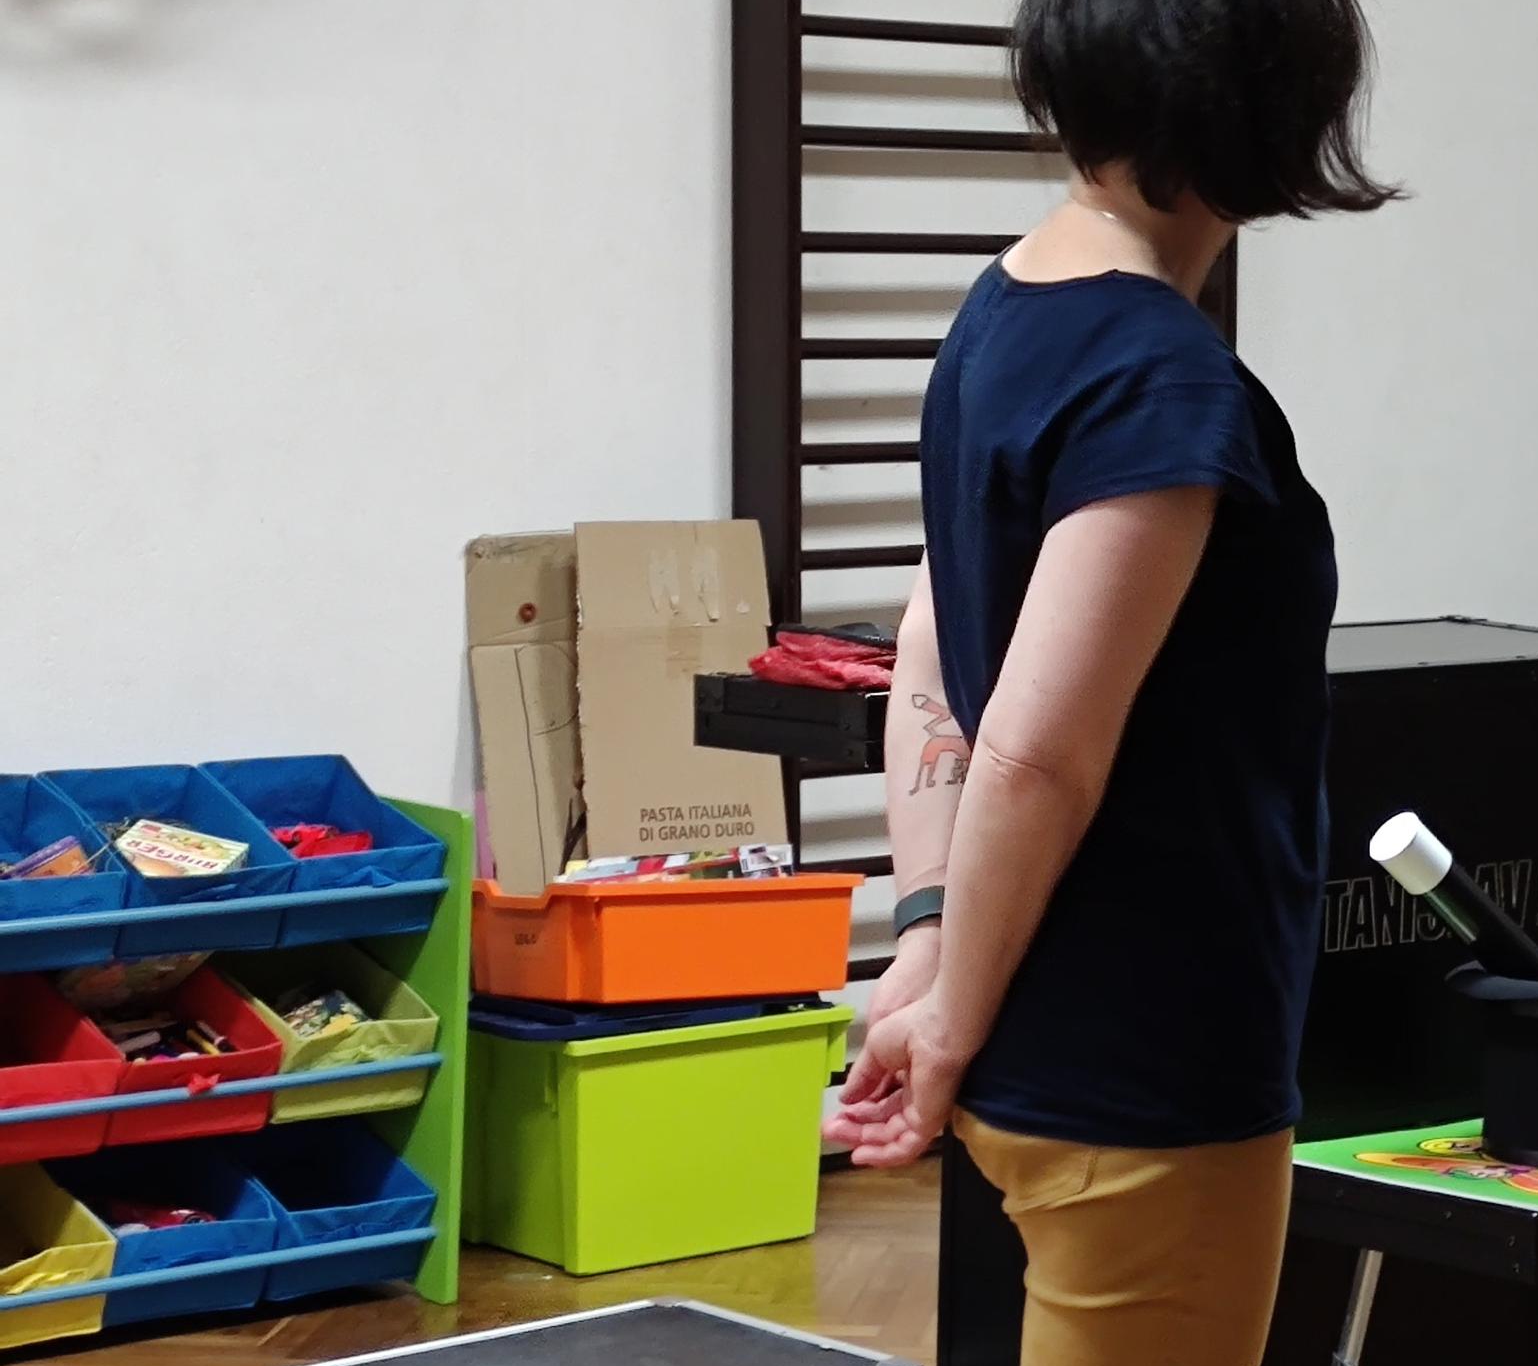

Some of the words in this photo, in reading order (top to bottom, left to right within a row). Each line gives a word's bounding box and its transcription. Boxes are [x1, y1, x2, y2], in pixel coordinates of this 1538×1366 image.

[640, 806, 684, 823] PASTA
[689, 803, 752, 820] ITALIANA
[639, 826, 654, 842] DI
[658, 823, 711, 841] GRANO
[715, 821, 755, 838] DURO
